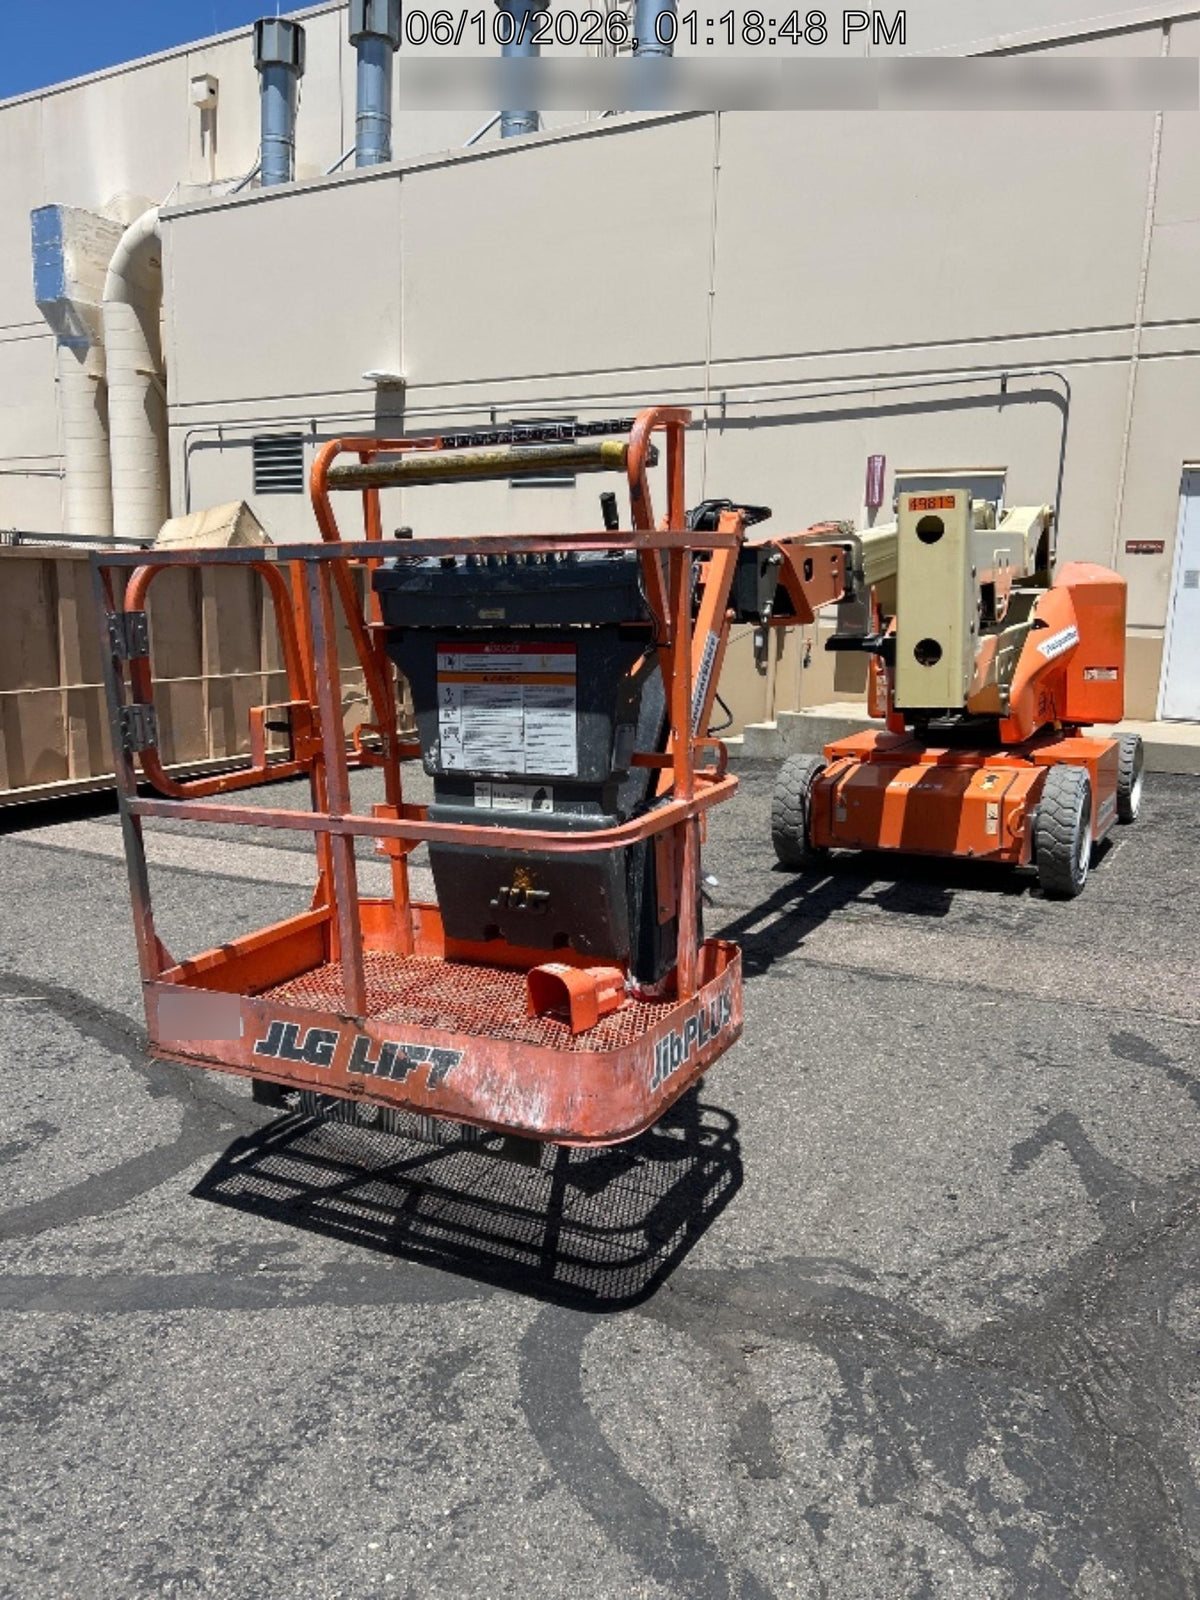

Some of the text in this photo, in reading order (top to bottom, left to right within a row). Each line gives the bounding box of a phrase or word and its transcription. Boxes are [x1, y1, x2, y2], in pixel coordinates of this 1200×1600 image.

[910, 494, 955, 511] 49819
[489, 886, 551, 913] JLG
[254, 1020, 465, 1091] JLG LIFT
